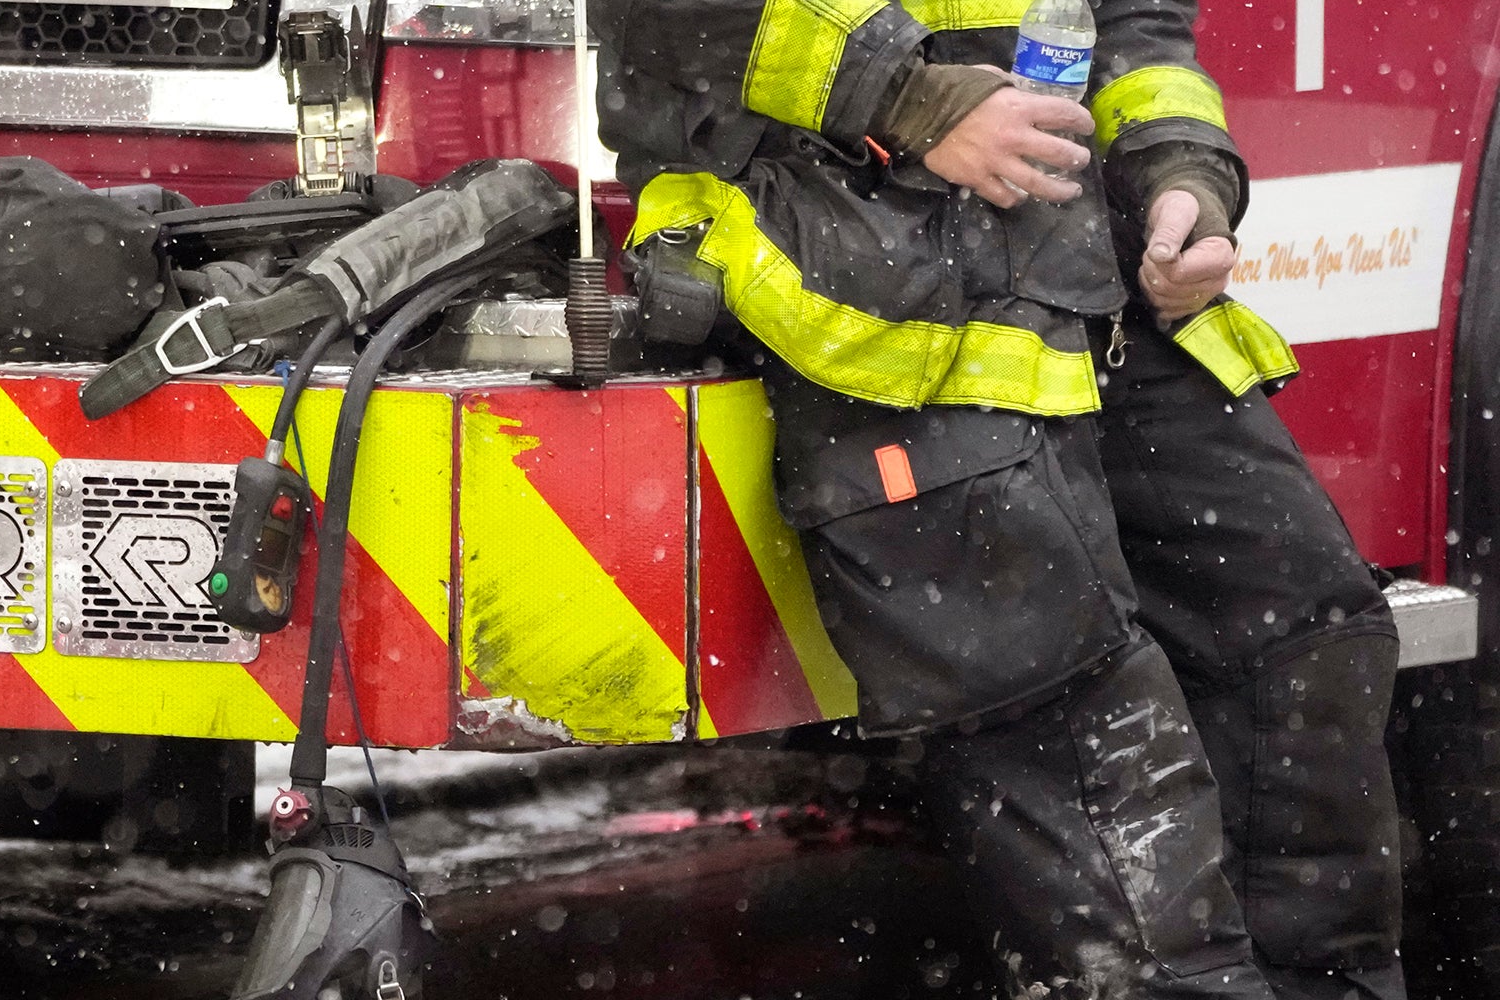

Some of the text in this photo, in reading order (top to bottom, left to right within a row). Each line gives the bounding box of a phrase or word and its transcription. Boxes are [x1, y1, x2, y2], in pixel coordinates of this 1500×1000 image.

[1041, 45, 1085, 63] Hinckley
[1268, 239, 1309, 281] When
[1314, 235, 1343, 290] You
[1347, 232, 1386, 276] Need
